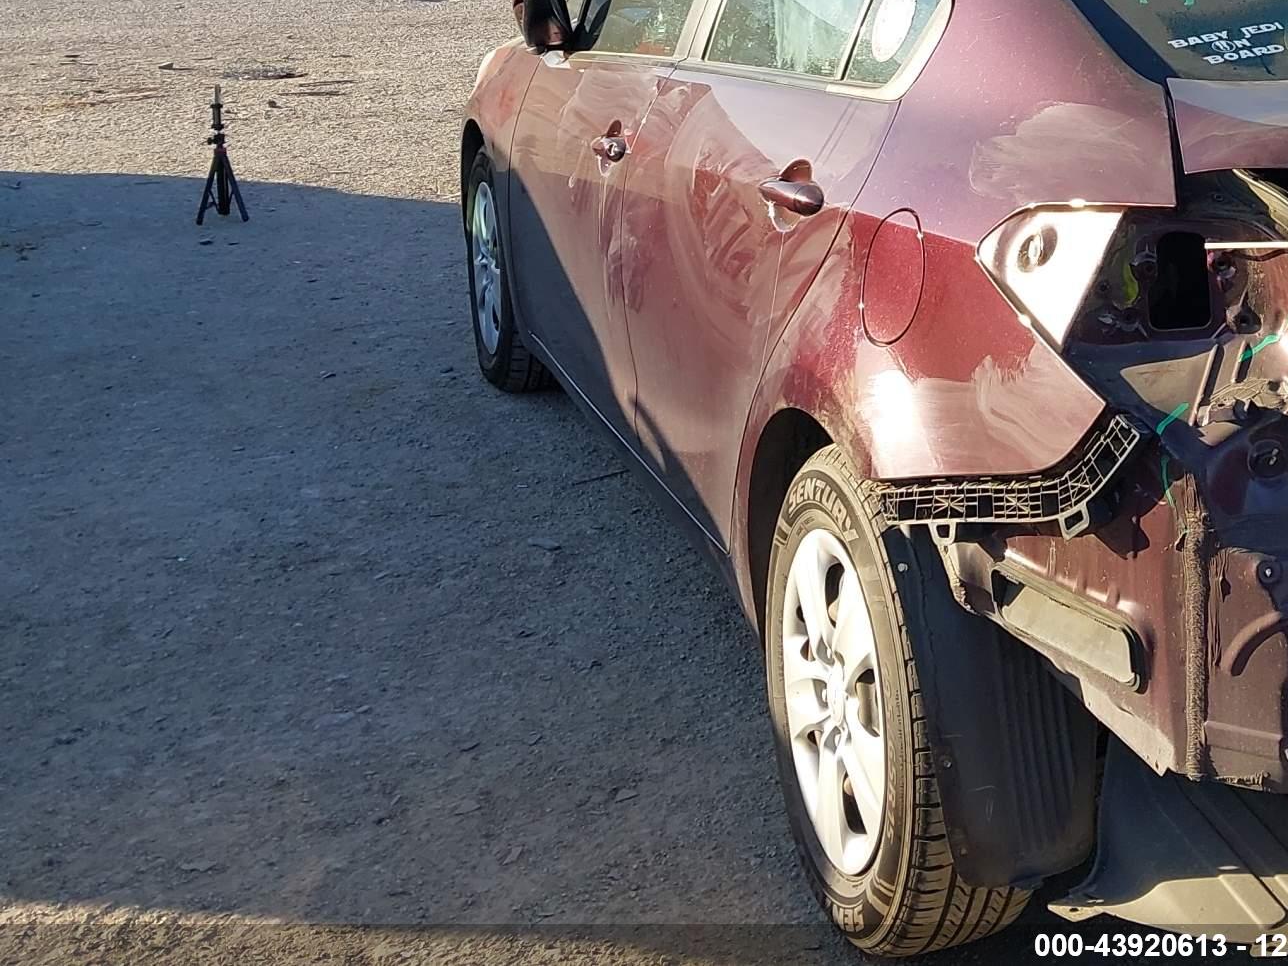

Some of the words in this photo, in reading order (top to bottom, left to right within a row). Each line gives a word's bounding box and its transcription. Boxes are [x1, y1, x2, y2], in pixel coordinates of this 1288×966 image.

[1167, 30, 1229, 49] BABY
[1240, 21, 1284, 39] JEDI
[1202, 44, 1285, 65] BOARD
[788, 477, 860, 542] SENTURY
